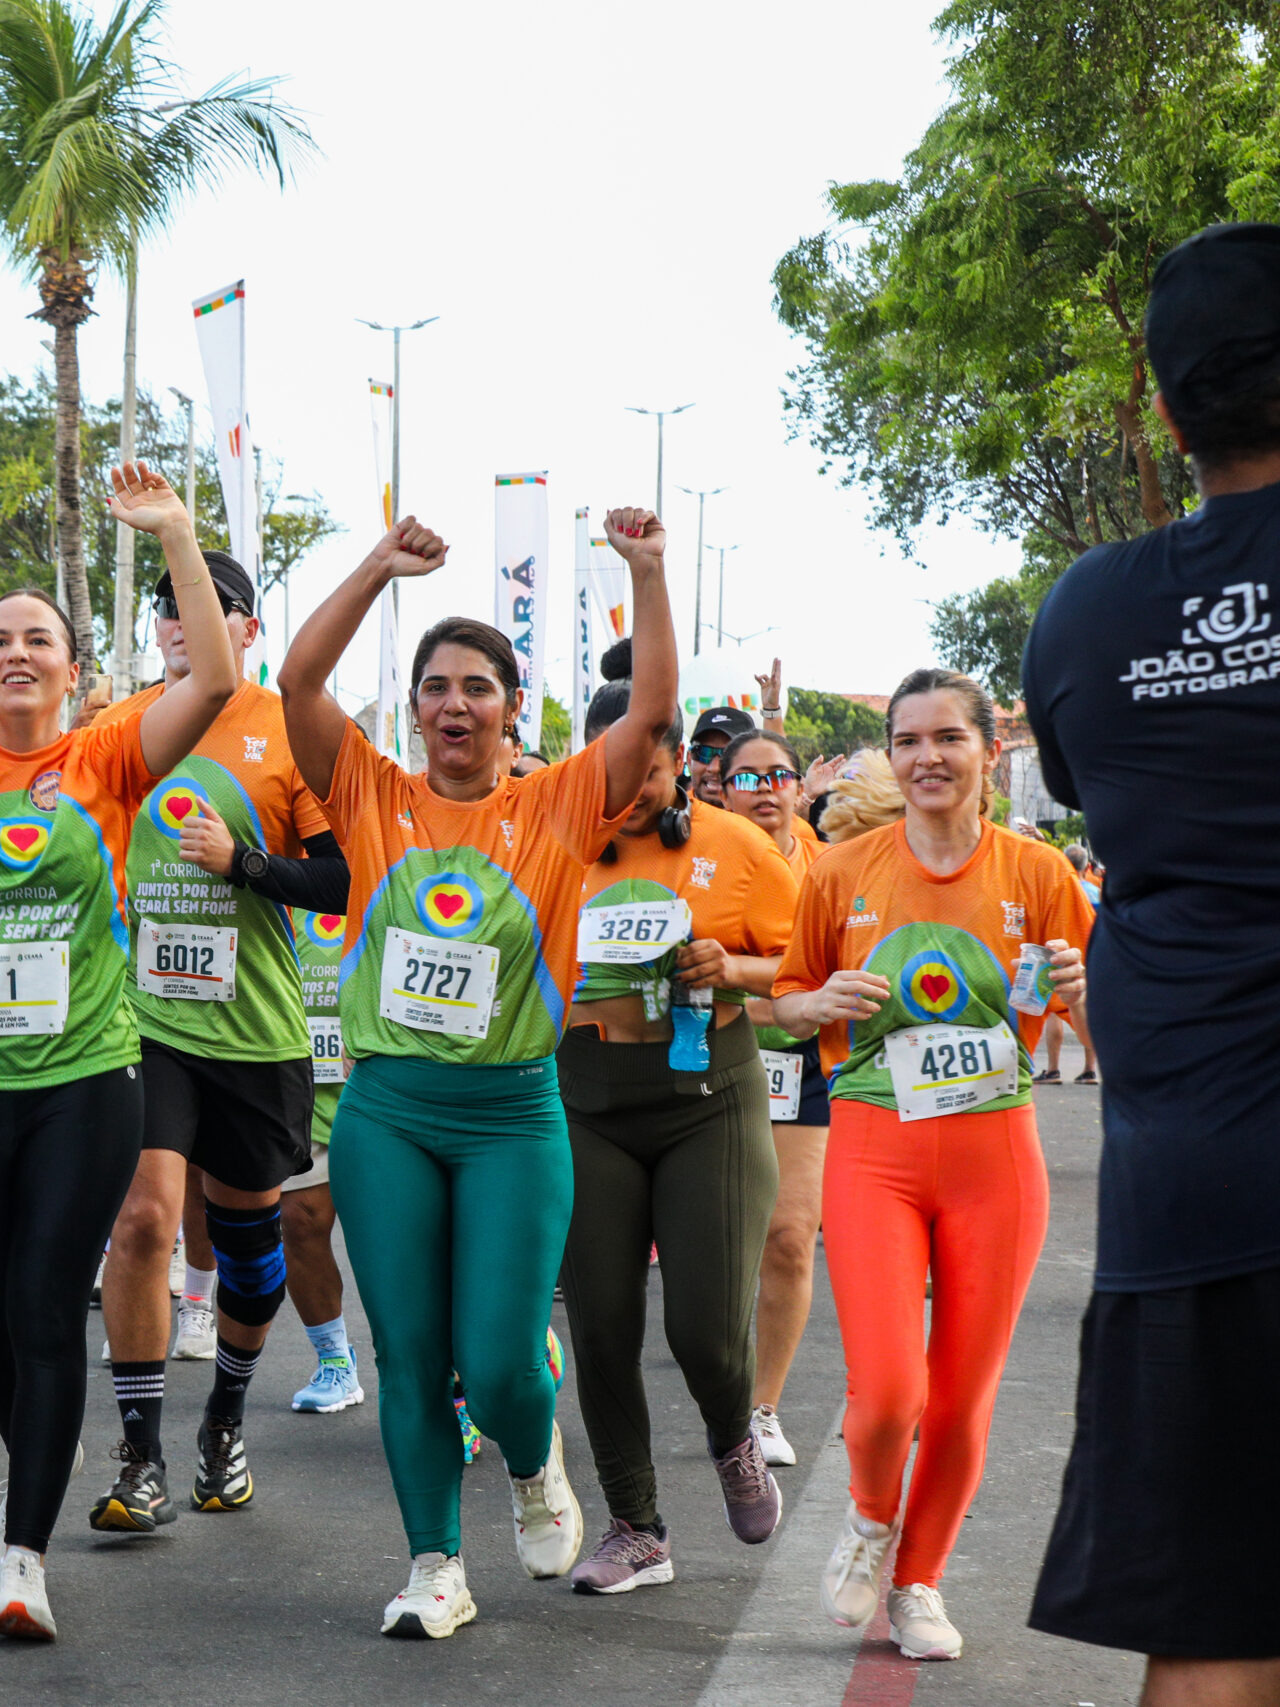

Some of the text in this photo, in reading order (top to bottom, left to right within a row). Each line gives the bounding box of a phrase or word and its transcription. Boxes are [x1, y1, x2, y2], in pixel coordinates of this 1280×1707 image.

[501, 556, 531, 720] EARÁ
[1119, 649, 1216, 682] JOÃO
[685, 693, 758, 715] CEAR
[151, 859, 161, 877] 1ª
[136, 882, 233, 899] JUNTOS POR UM
[18, 904, 54, 922] POR
[134, 898, 238, 915] CEARÁ SEM FOME
[2, 923, 37, 939] SEM
[598, 918, 669, 943] 3267
[157, 944, 214, 975] 6012
[311, 965, 340, 978] CORR
[403, 958, 472, 1000] 2727
[6, 968, 17, 1000] 1
[302, 981, 339, 994] TOS PO
[921, 1039, 993, 1081] 4281
